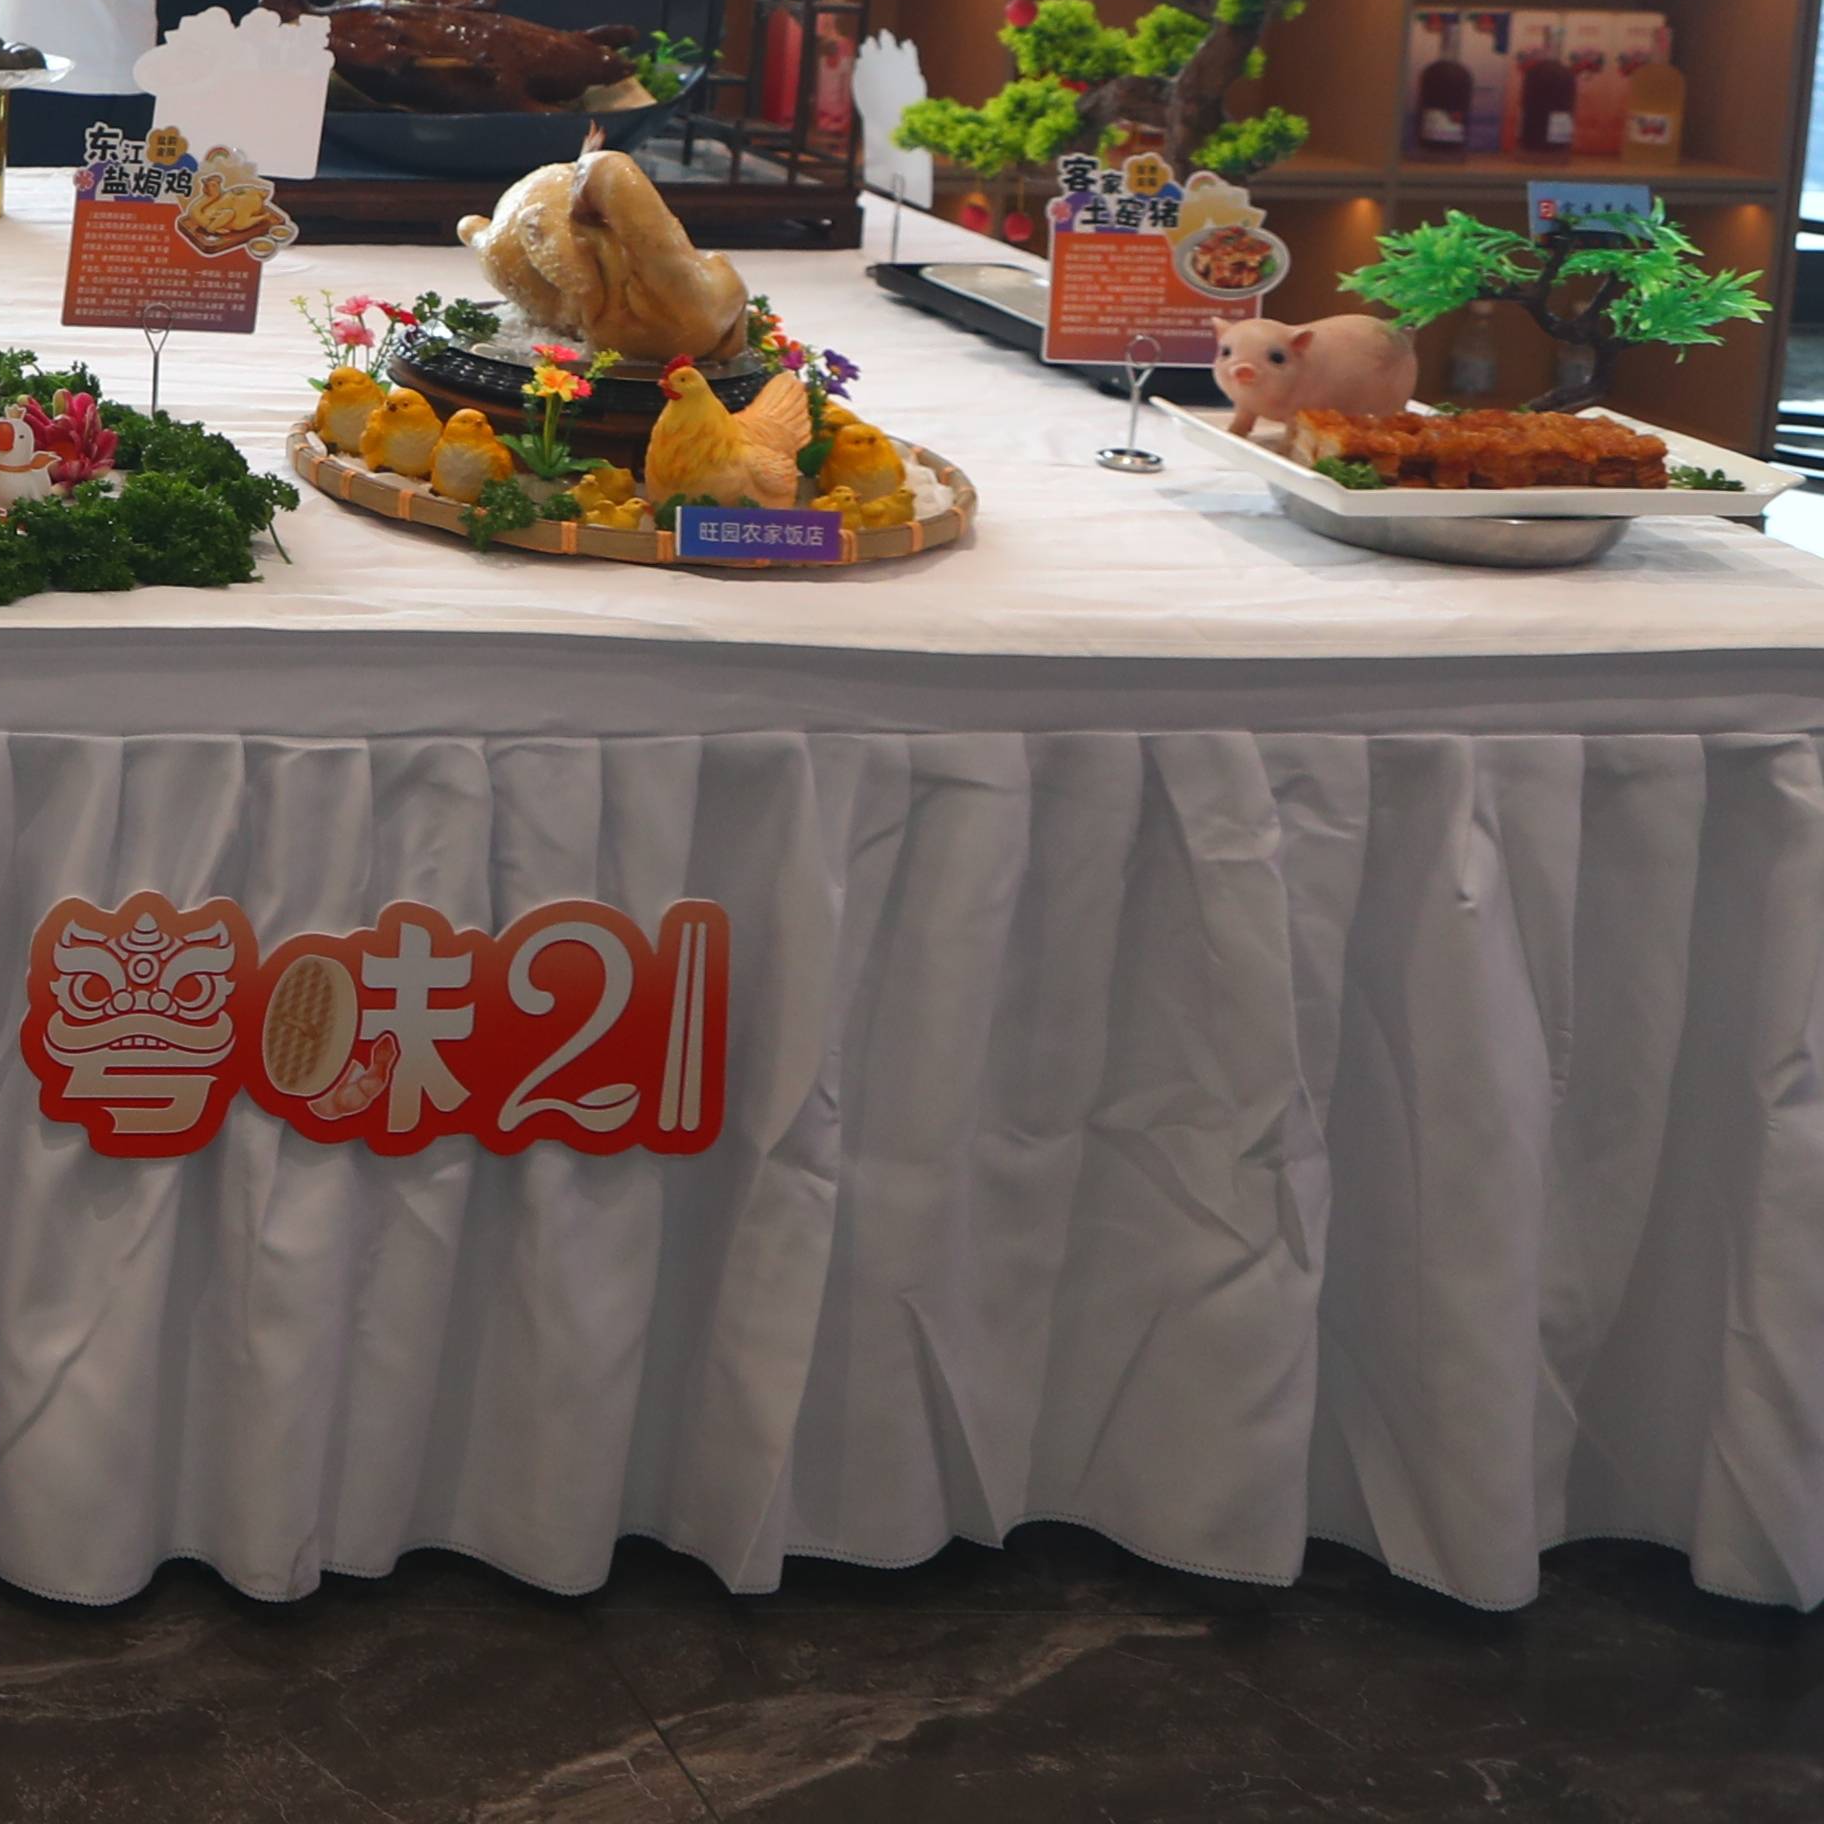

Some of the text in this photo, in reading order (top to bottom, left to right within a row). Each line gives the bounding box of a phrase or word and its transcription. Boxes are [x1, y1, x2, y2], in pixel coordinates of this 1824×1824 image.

[87, 127, 144, 164] 东江
[102, 166, 193, 197] 盐焗鸡
[1063, 156, 1122, 193] 客家
[1081, 197, 1179, 228] 土窑猪
[699, 522, 824, 546] 旺园农家饭店
